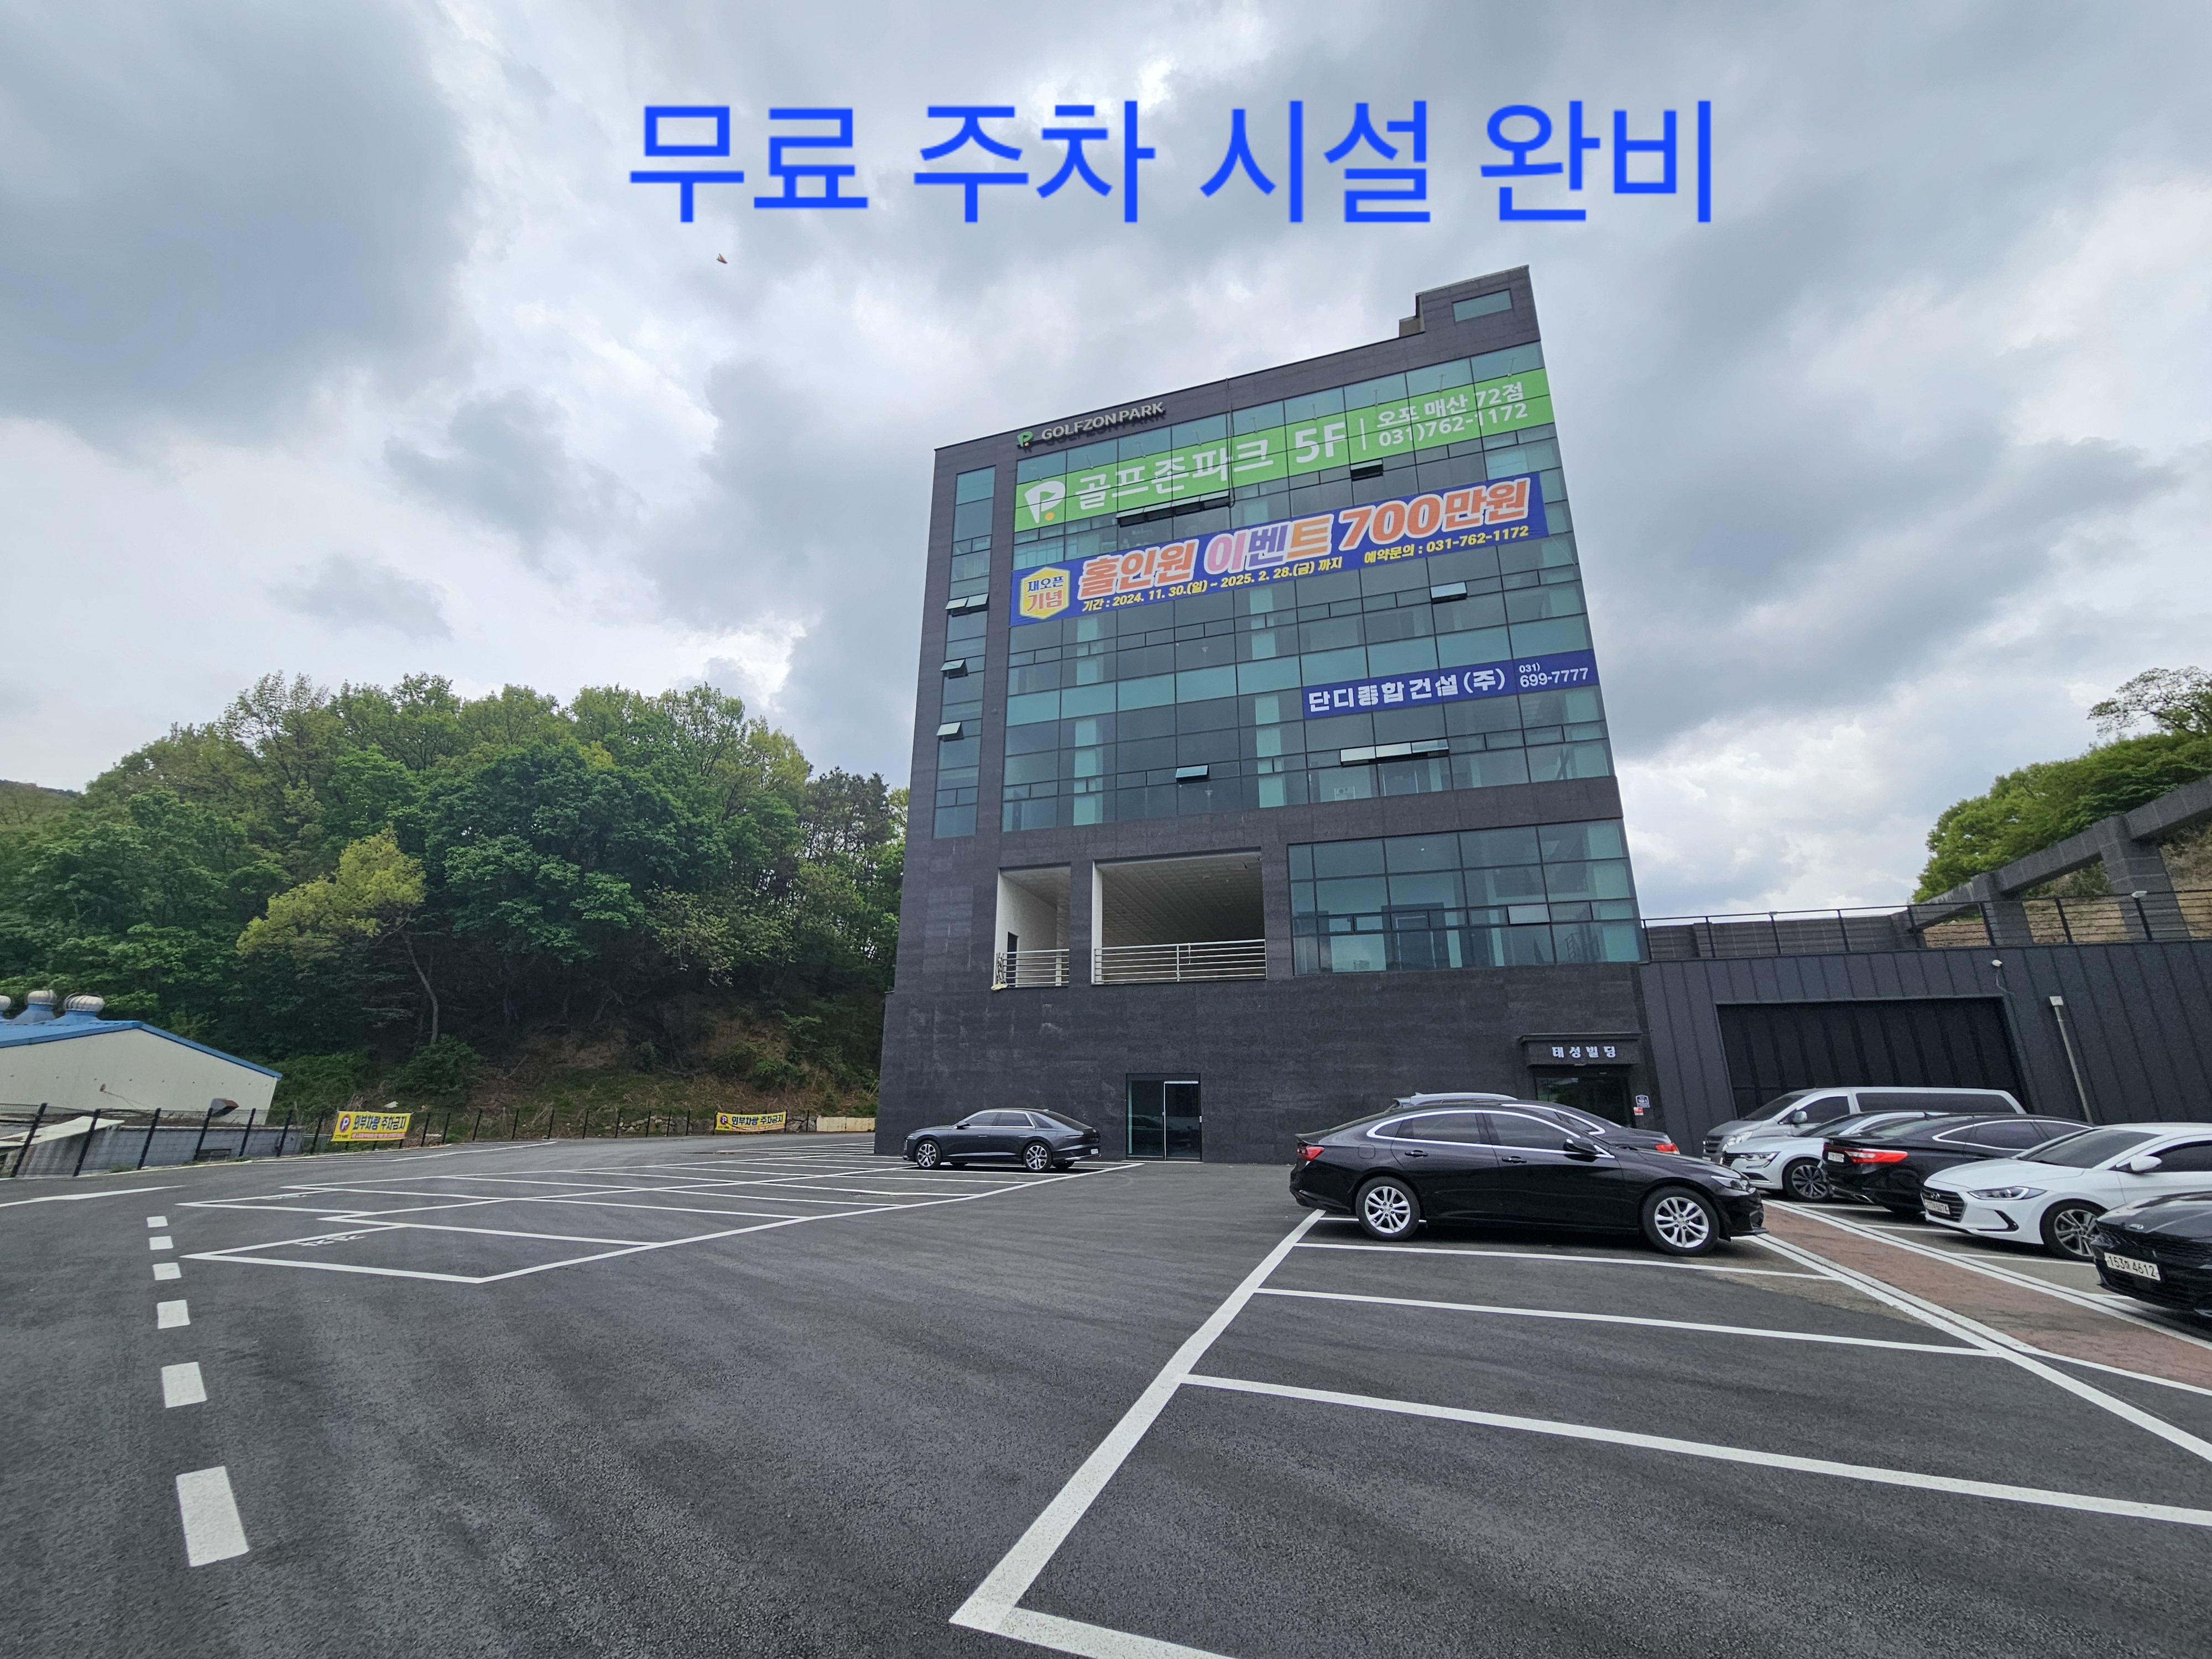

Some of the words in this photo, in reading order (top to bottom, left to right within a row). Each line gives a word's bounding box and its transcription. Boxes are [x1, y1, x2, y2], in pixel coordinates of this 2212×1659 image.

[1376, 405, 1420, 429] 오포
[1424, 394, 1468, 419] 매산
[1475, 381, 1524, 407] 72점
[1379, 403, 1528, 447] 031)762-1172
[1075, 439, 1274, 510] 골프존파크
[1295, 422, 1346, 464] 5F
[1078, 540, 1199, 599] 홀인원
[1205, 515, 1333, 574] 이벤트
[1339, 478, 1530, 550] 700만원
[1364, 544, 1415, 564] 예약문의
[1426, 525, 1529, 552] 031-762-1172
[1027, 575, 1065, 592] 재오픈
[1082, 600, 1105, 613] 기간
[1318, 556, 1343, 572] 까지
[1027, 592, 1063, 612] 기념
[1519, 662, 1541, 674] 031)
[1519, 667, 1589, 688] 699-7777
[1551, 1046, 1616, 1058] 태성빌딩
[381, 1115, 407, 1130] 주차금지
[2132, 1261, 2156, 1277] 4612
